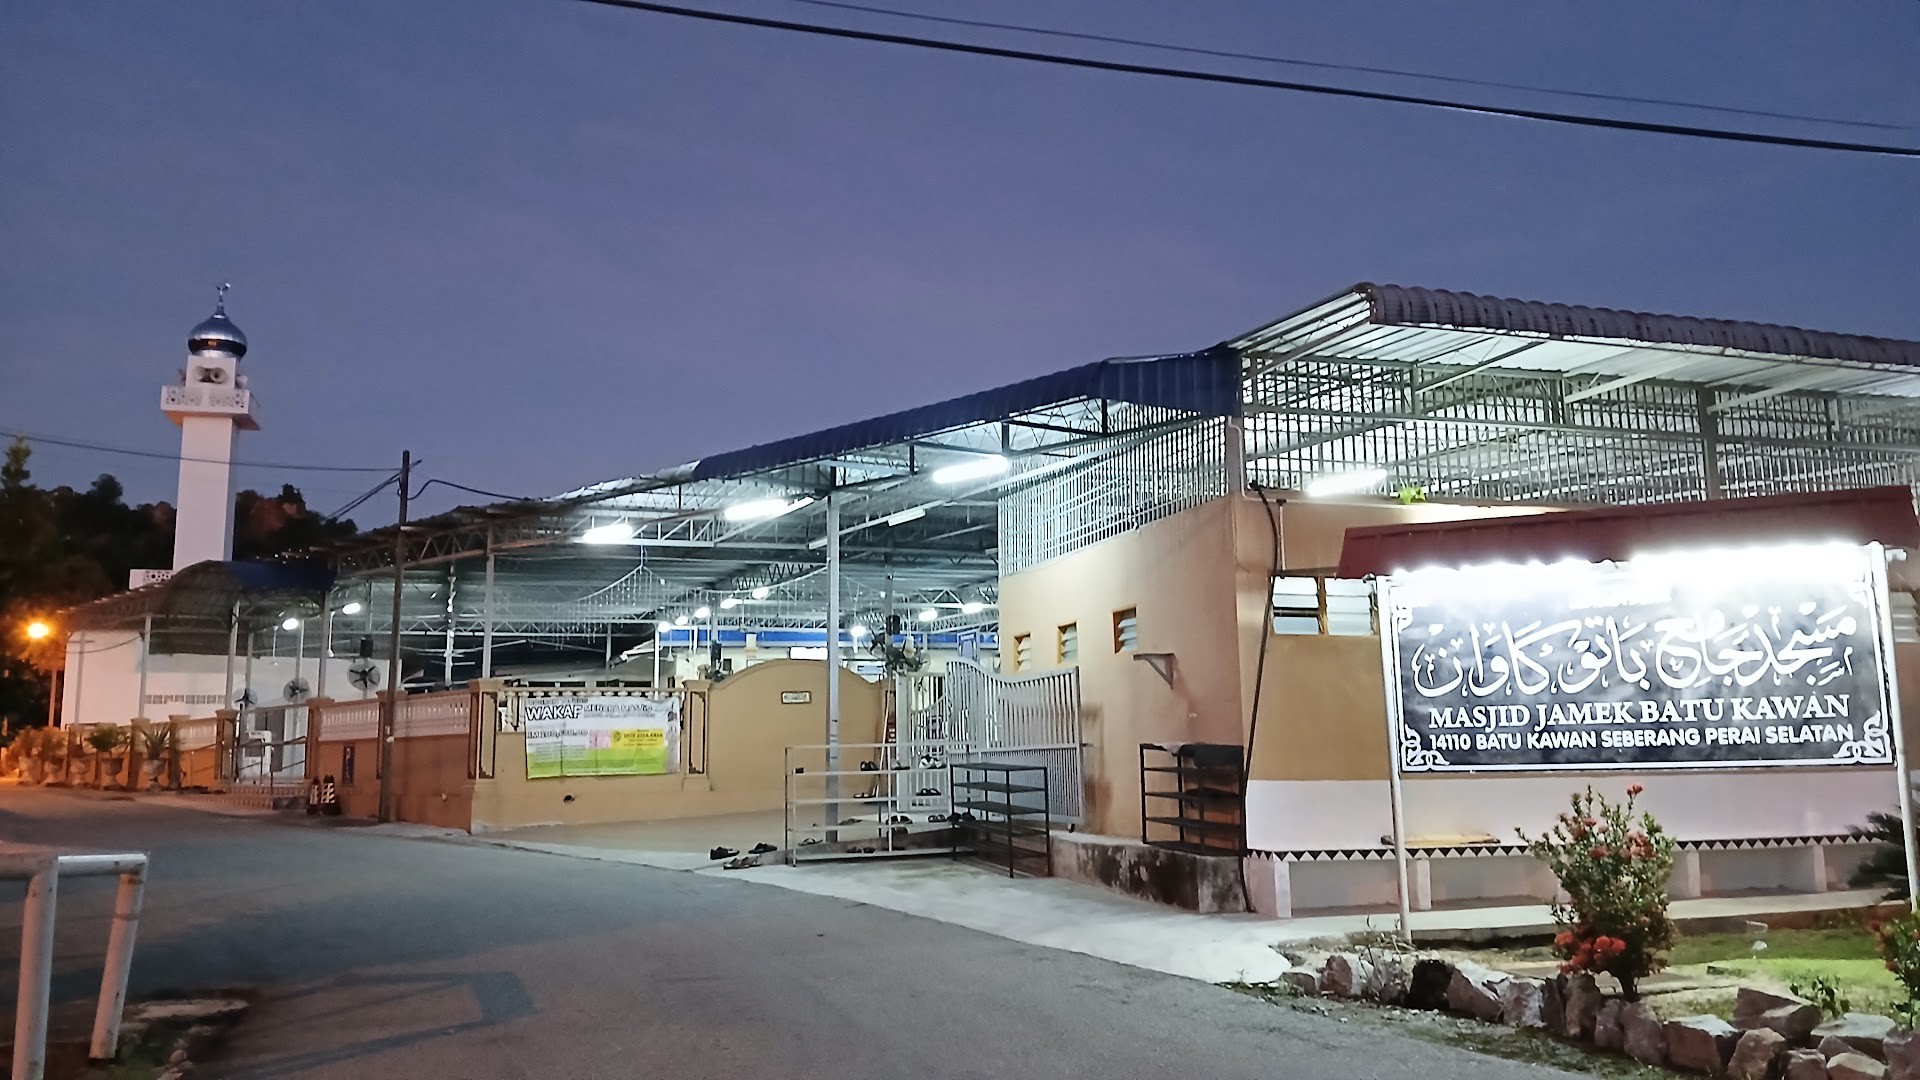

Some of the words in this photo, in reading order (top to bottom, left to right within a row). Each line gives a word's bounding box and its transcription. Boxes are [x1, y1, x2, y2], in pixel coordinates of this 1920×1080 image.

[525, 704, 583, 721] WAKAF
[1428, 704, 1531, 733] MASJID
[1534, 701, 1636, 732] JAMEK
[1638, 698, 1725, 723] BATU
[1730, 694, 1850, 721] KAWAN
[1429, 733, 1471, 750] 14110
[1475, 732, 1522, 750] BATU
[1527, 730, 1597, 749] KAWAN
[1601, 727, 1701, 748] SEBERANG
[1704, 726, 1761, 745] PERAI
[1765, 723, 1854, 744] SELATAN
